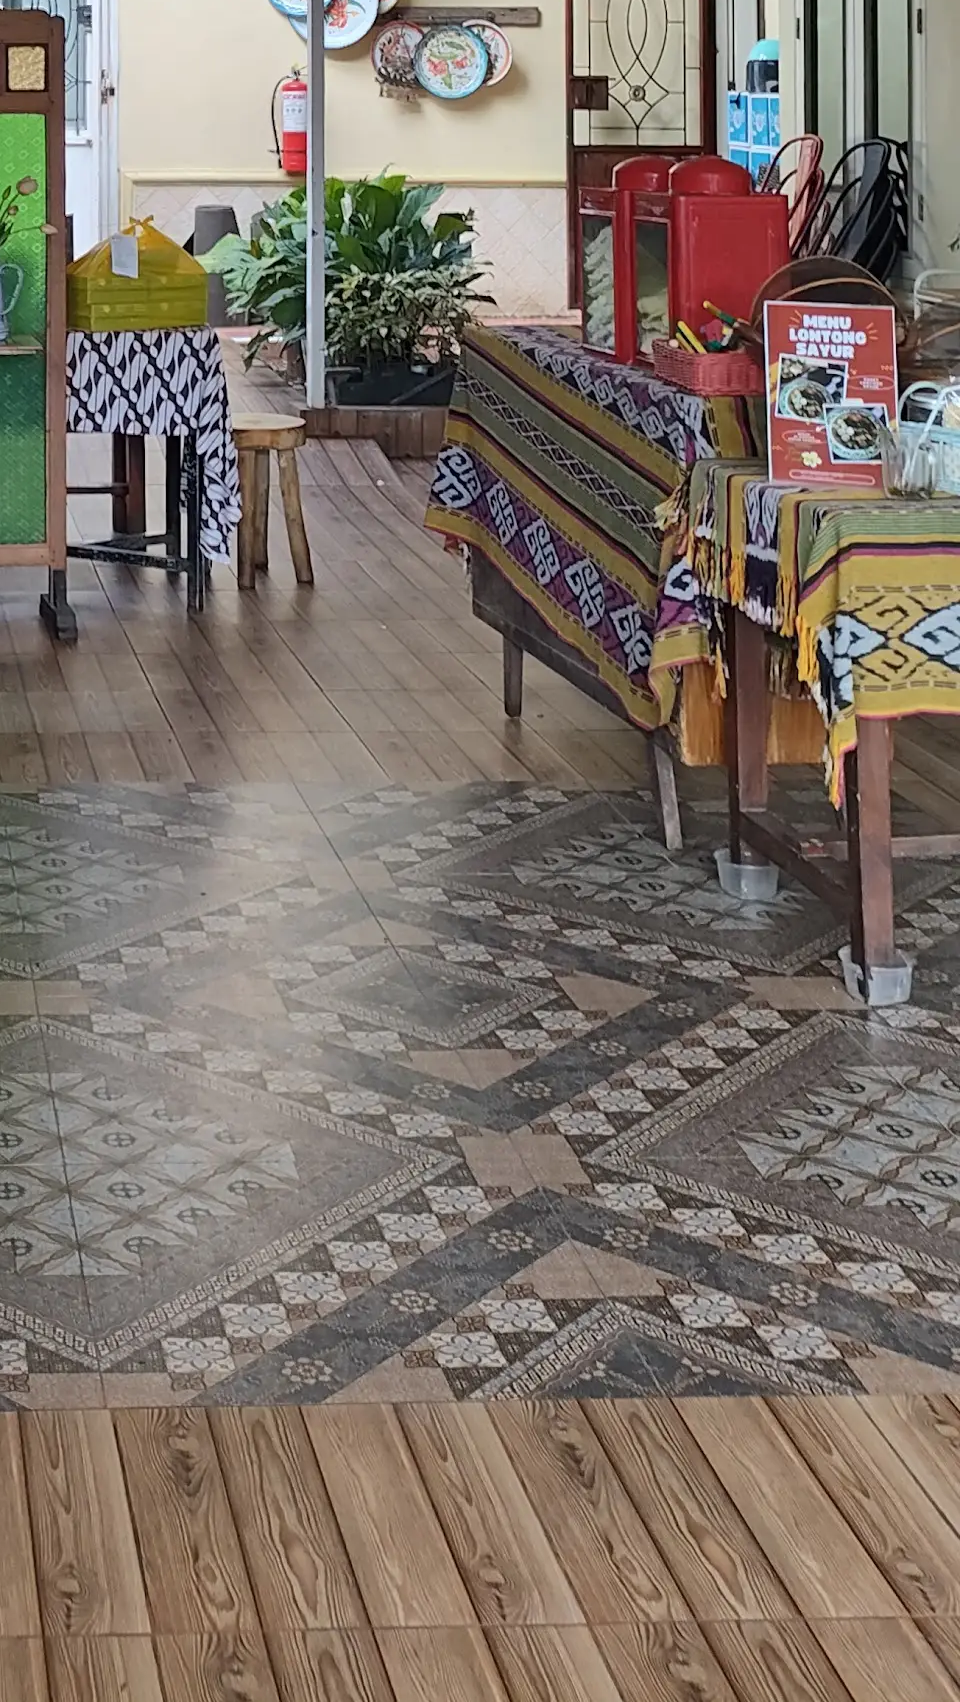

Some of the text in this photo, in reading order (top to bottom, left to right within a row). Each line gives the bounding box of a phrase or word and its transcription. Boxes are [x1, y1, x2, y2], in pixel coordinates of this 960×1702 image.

[803, 314, 852, 330] MENU
[789, 327, 867, 346] LONTONG
[795, 342, 855, 359] SAYUR
